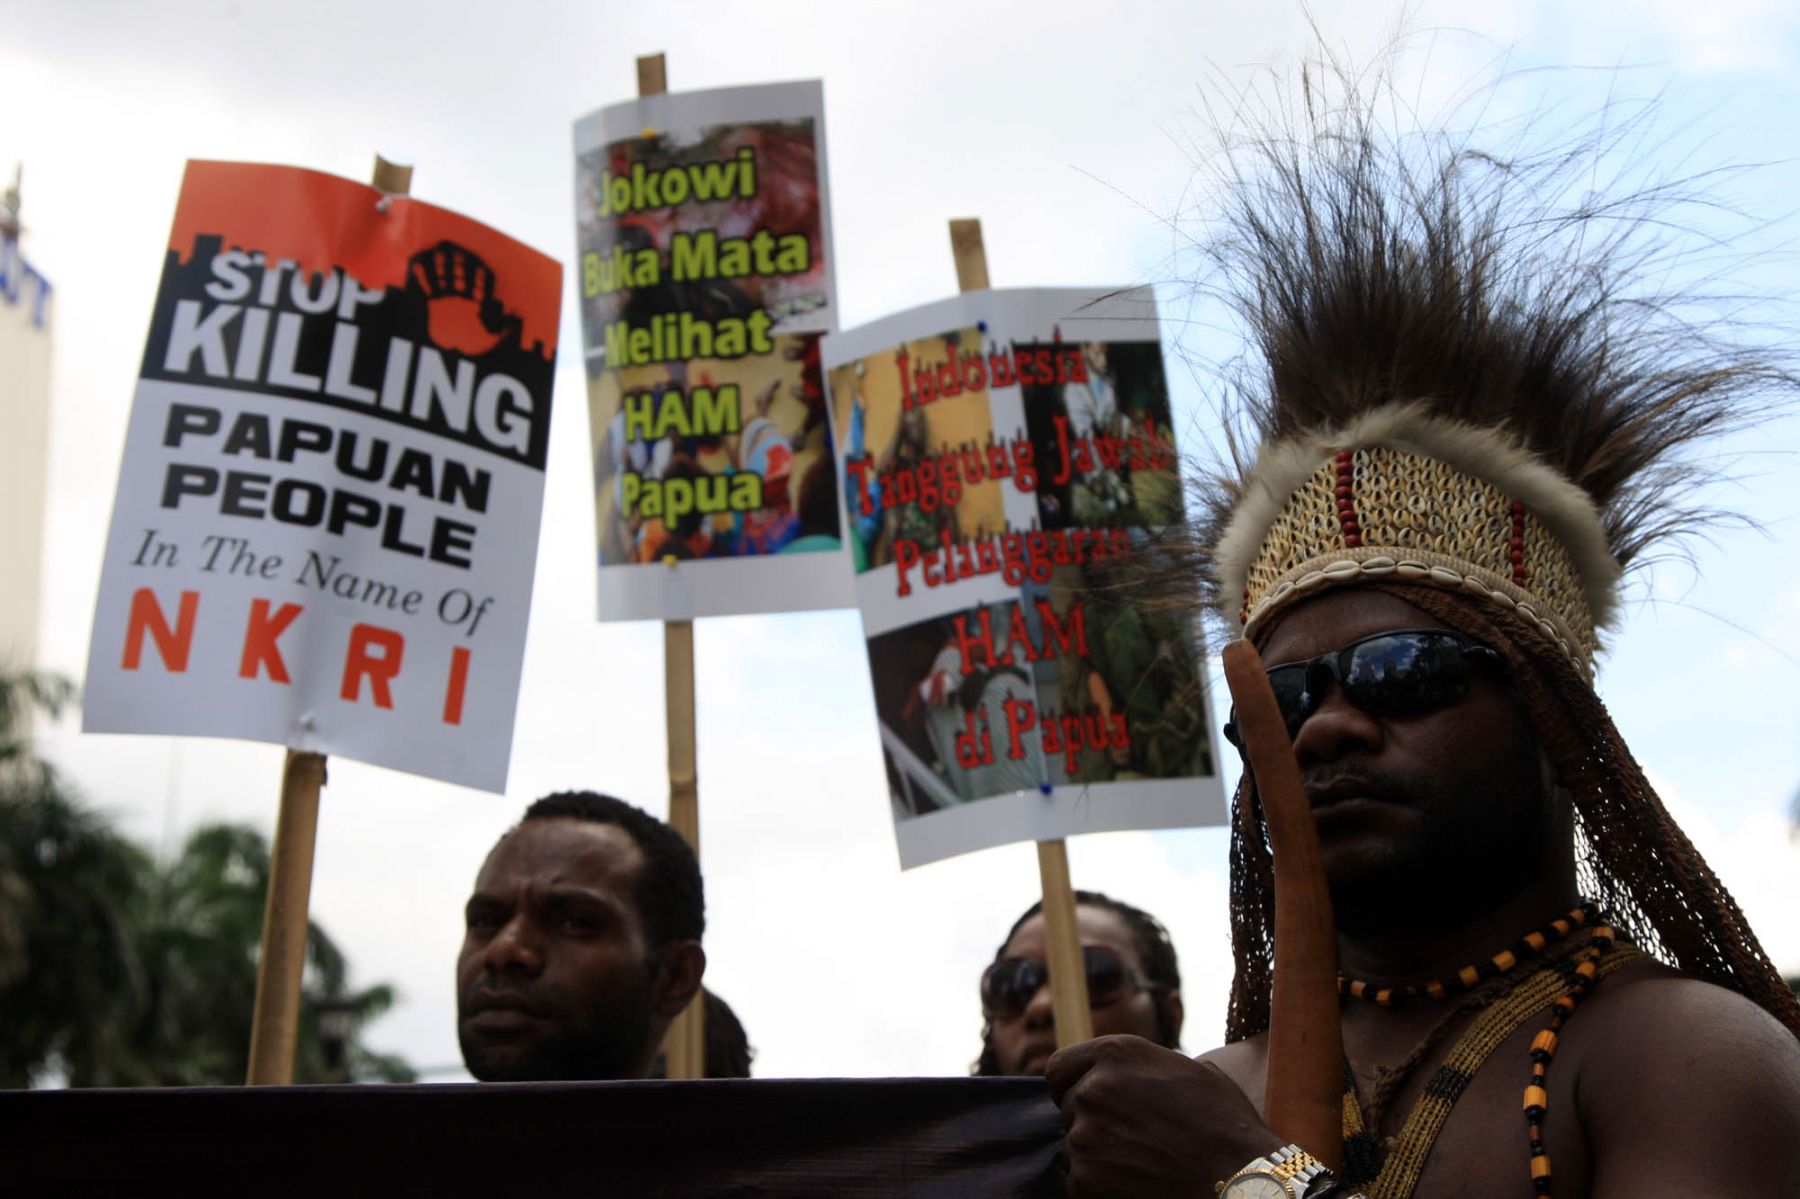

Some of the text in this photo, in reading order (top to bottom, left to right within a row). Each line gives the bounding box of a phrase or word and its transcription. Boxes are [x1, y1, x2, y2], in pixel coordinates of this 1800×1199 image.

[599, 148, 756, 218] Jokowi
[205, 249, 386, 320] STOP
[583, 230, 809, 297] Buka Mata
[163, 299, 534, 456] KILLING
[604, 309, 774, 368] Melihat
[896, 328, 1088, 411] Indonesia
[624, 385, 740, 443] HAM
[163, 402, 492, 514] PAPUAN
[847, 411, 1174, 516] Tanggung Jawab
[160, 463, 477, 569] PEOPLE
[621, 470, 762, 530] Papua
[130, 529, 495, 636] In The Name Of
[894, 521, 1132, 597] Pelanggaran
[121, 586, 471, 726] NKRI
[953, 598, 1090, 675] HAM
[955, 691, 1131, 775] di Papua
